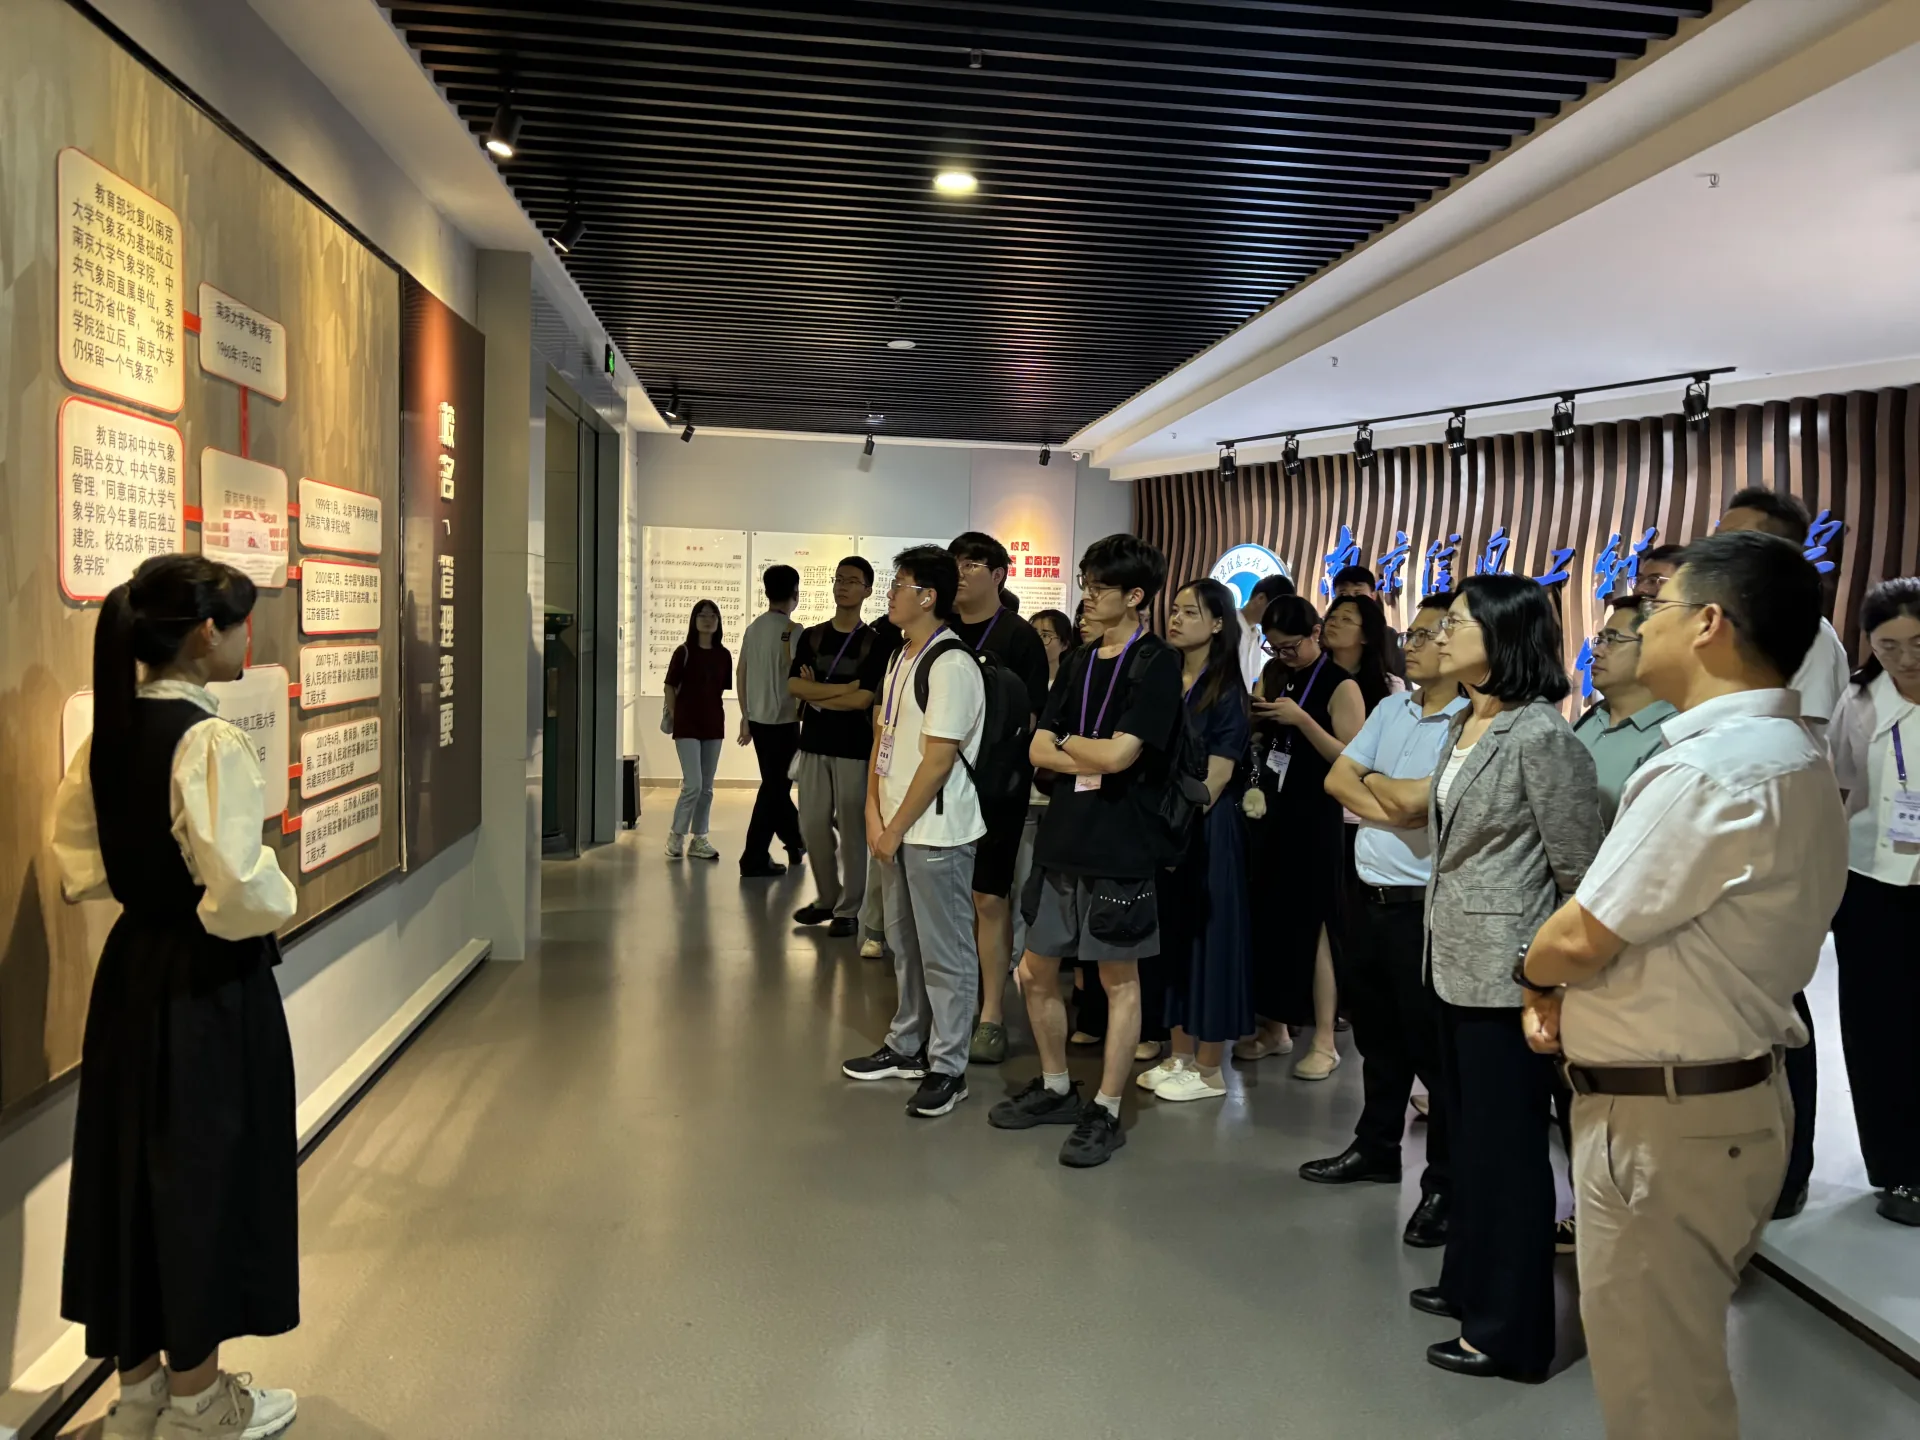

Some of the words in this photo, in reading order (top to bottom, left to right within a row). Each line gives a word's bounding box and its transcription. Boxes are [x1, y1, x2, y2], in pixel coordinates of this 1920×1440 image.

[96, 424, 175, 463] 教育部和中央气象
